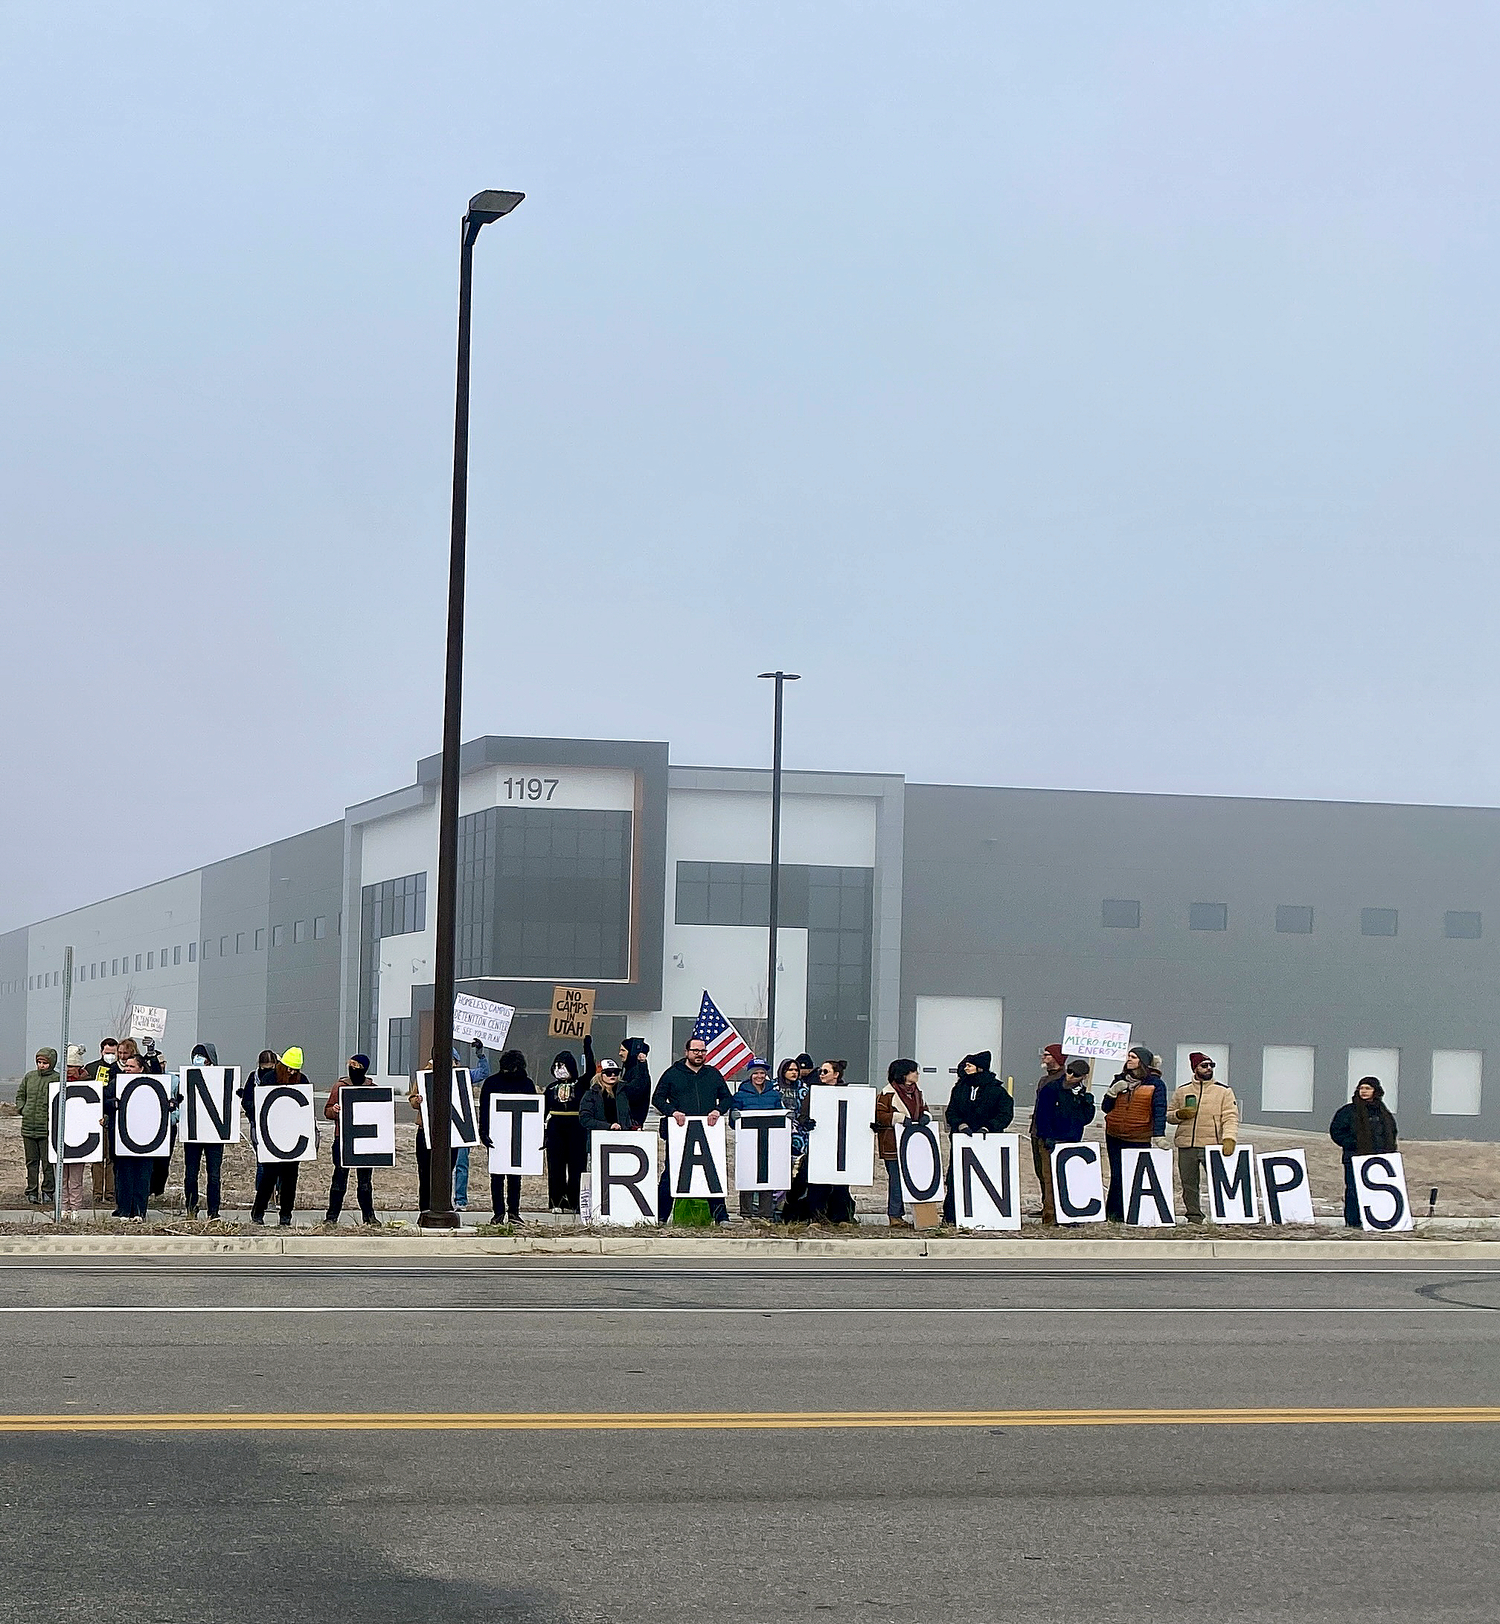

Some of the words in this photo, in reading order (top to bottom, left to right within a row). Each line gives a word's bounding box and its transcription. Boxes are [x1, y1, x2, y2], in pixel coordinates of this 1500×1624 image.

[503, 777, 559, 801] 1197
[566, 991, 582, 1001] NO
[135, 1005, 146, 1014] NO
[556, 1000, 589, 1014] CAMPS
[454, 1008, 487, 1027] DETENTION
[487, 1019, 510, 1032] CENTER
[566, 1013, 575, 1021] IN
[1075, 1017, 1099, 1028] ICE
[461, 1026, 473, 1036] SEE
[554, 1018, 585, 1037] UTAH
[1065, 1036, 1099, 1046] MICRO
[1102, 1040, 1127, 1049] PENIS
[1078, 1046, 1118, 1056] ENERGY
